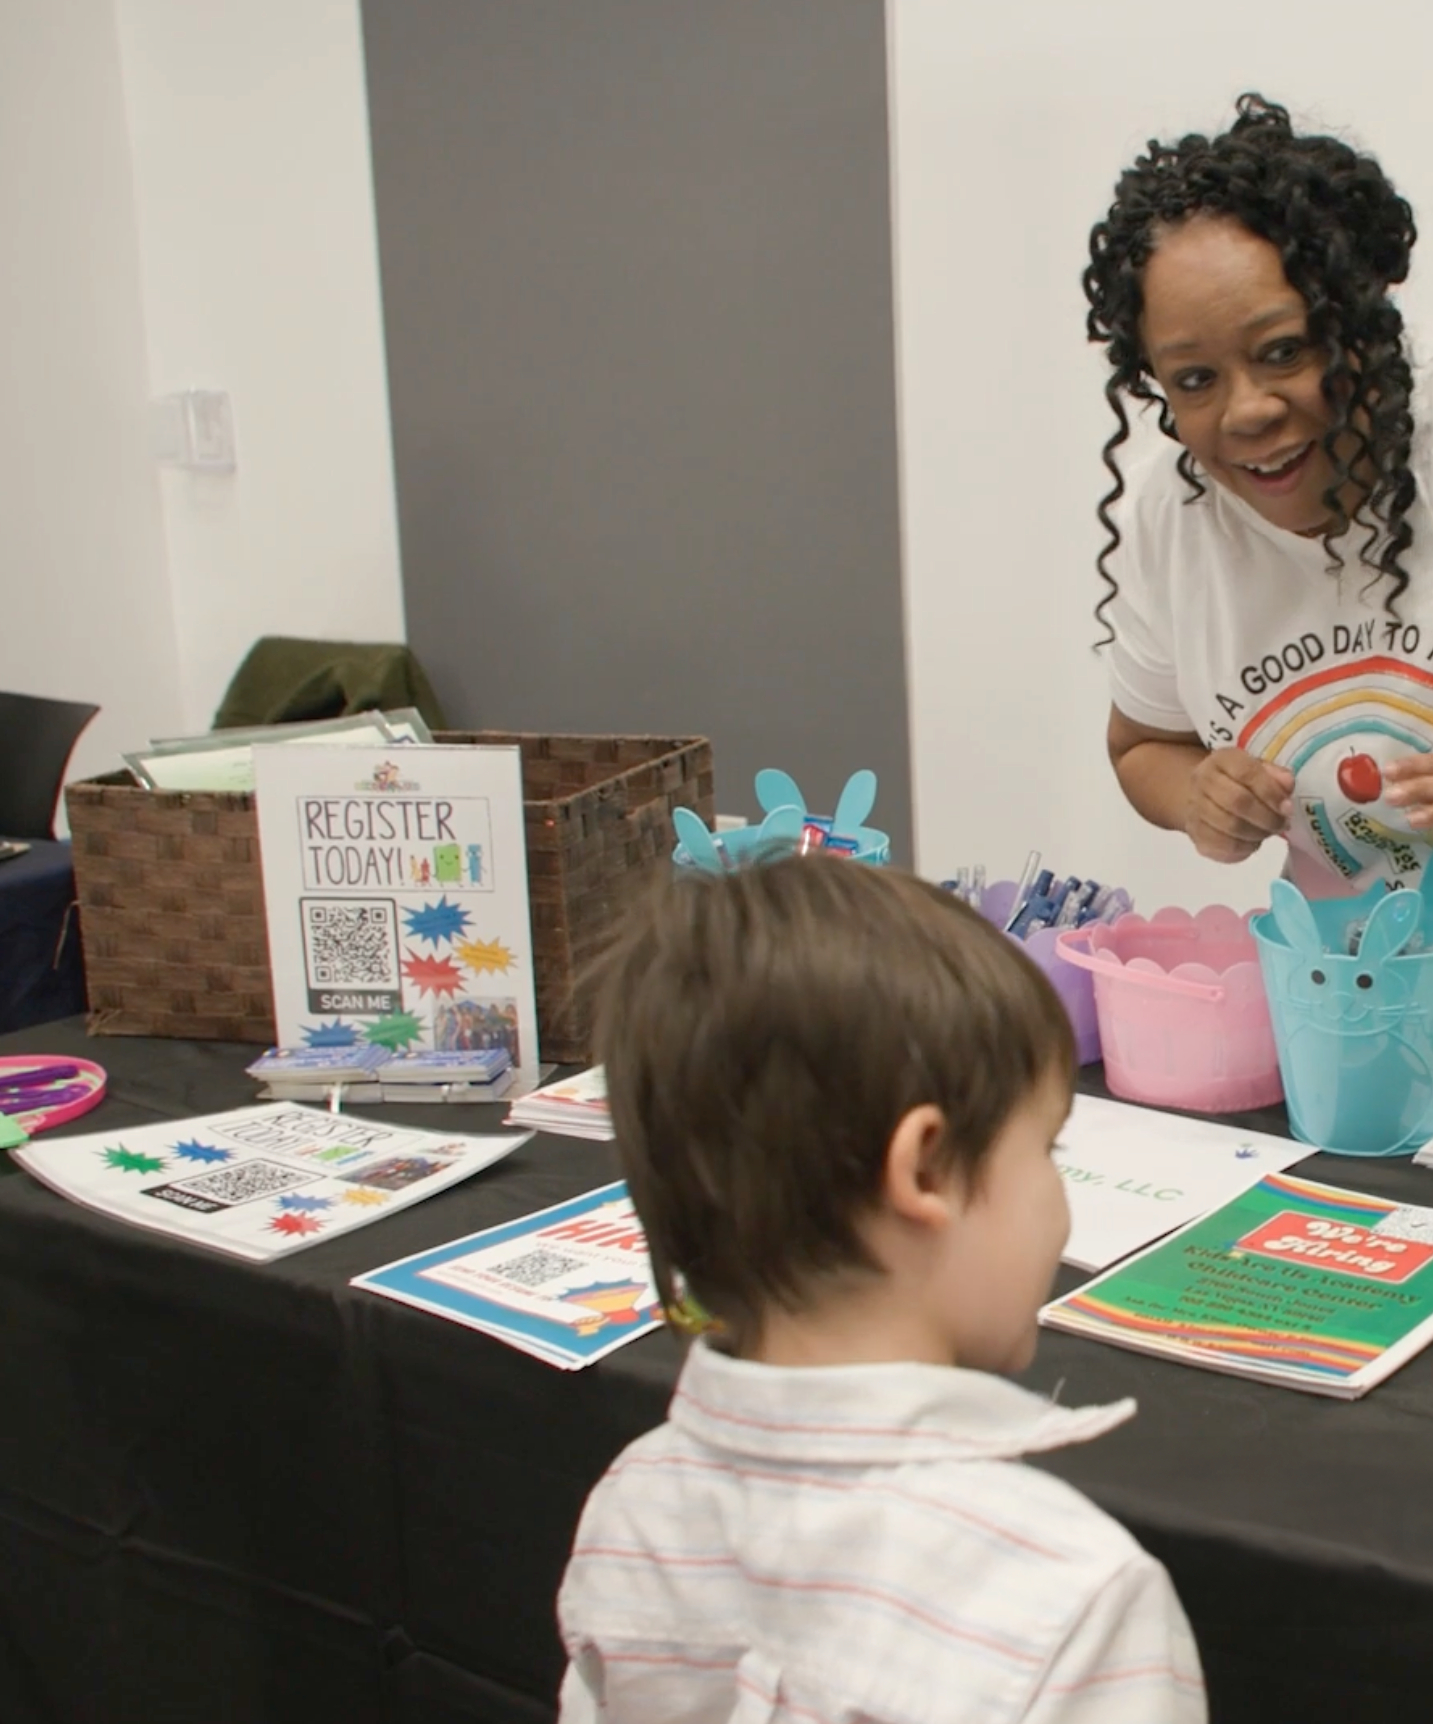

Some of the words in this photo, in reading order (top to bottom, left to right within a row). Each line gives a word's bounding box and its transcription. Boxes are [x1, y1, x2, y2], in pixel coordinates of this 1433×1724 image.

[1215, 693, 1245, 721] A
[1240, 632, 1325, 695] GOOD
[1333, 618, 1376, 655] DAY
[1385, 621, 1420, 654] TO
[305, 800, 457, 841] REGISTER
[308, 846, 406, 886] TODAY!
[321, 994, 363, 1010] SCAN
[366, 996, 392, 1011] ME
[262, 1110, 394, 1149] REGISTER
[1058, 1163, 1105, 1186] my,
[1114, 1178, 1185, 1202] LLC
[536, 1219, 650, 1253] HIR
[1263, 1235, 1397, 1274] Hiring
[1305, 1220, 1408, 1254] We're
[1183, 1245, 1232, 1262] Kids
[1241, 1256, 1278, 1273] Are
[1320, 1275, 1423, 1306] Academy
[1187, 1261, 1298, 1294] Childcare
[1301, 1287, 1385, 1311] Center
